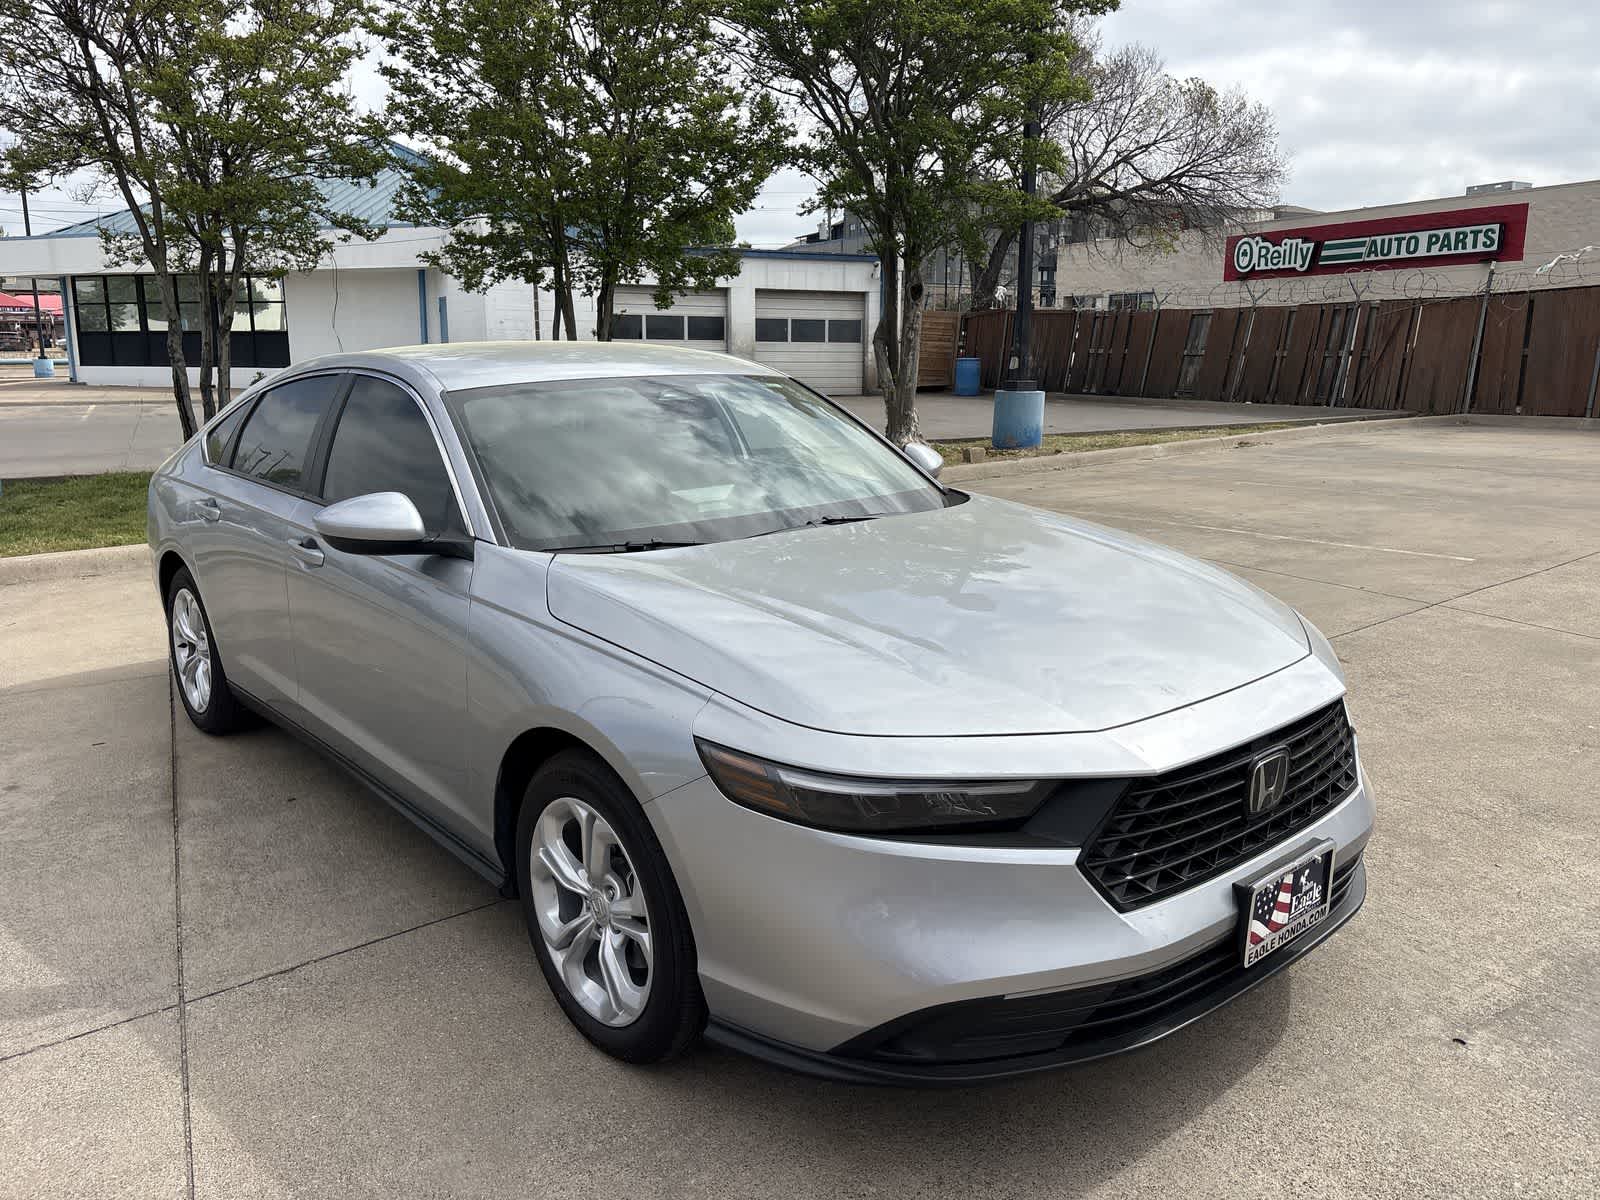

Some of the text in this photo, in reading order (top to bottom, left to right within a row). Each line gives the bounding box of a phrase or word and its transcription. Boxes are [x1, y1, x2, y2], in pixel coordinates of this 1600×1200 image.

[1236, 238, 1313, 271] O'Reilly
[1367, 228, 1496, 258] AUTO PARTS
[1291, 882, 1322, 914] Eagle
